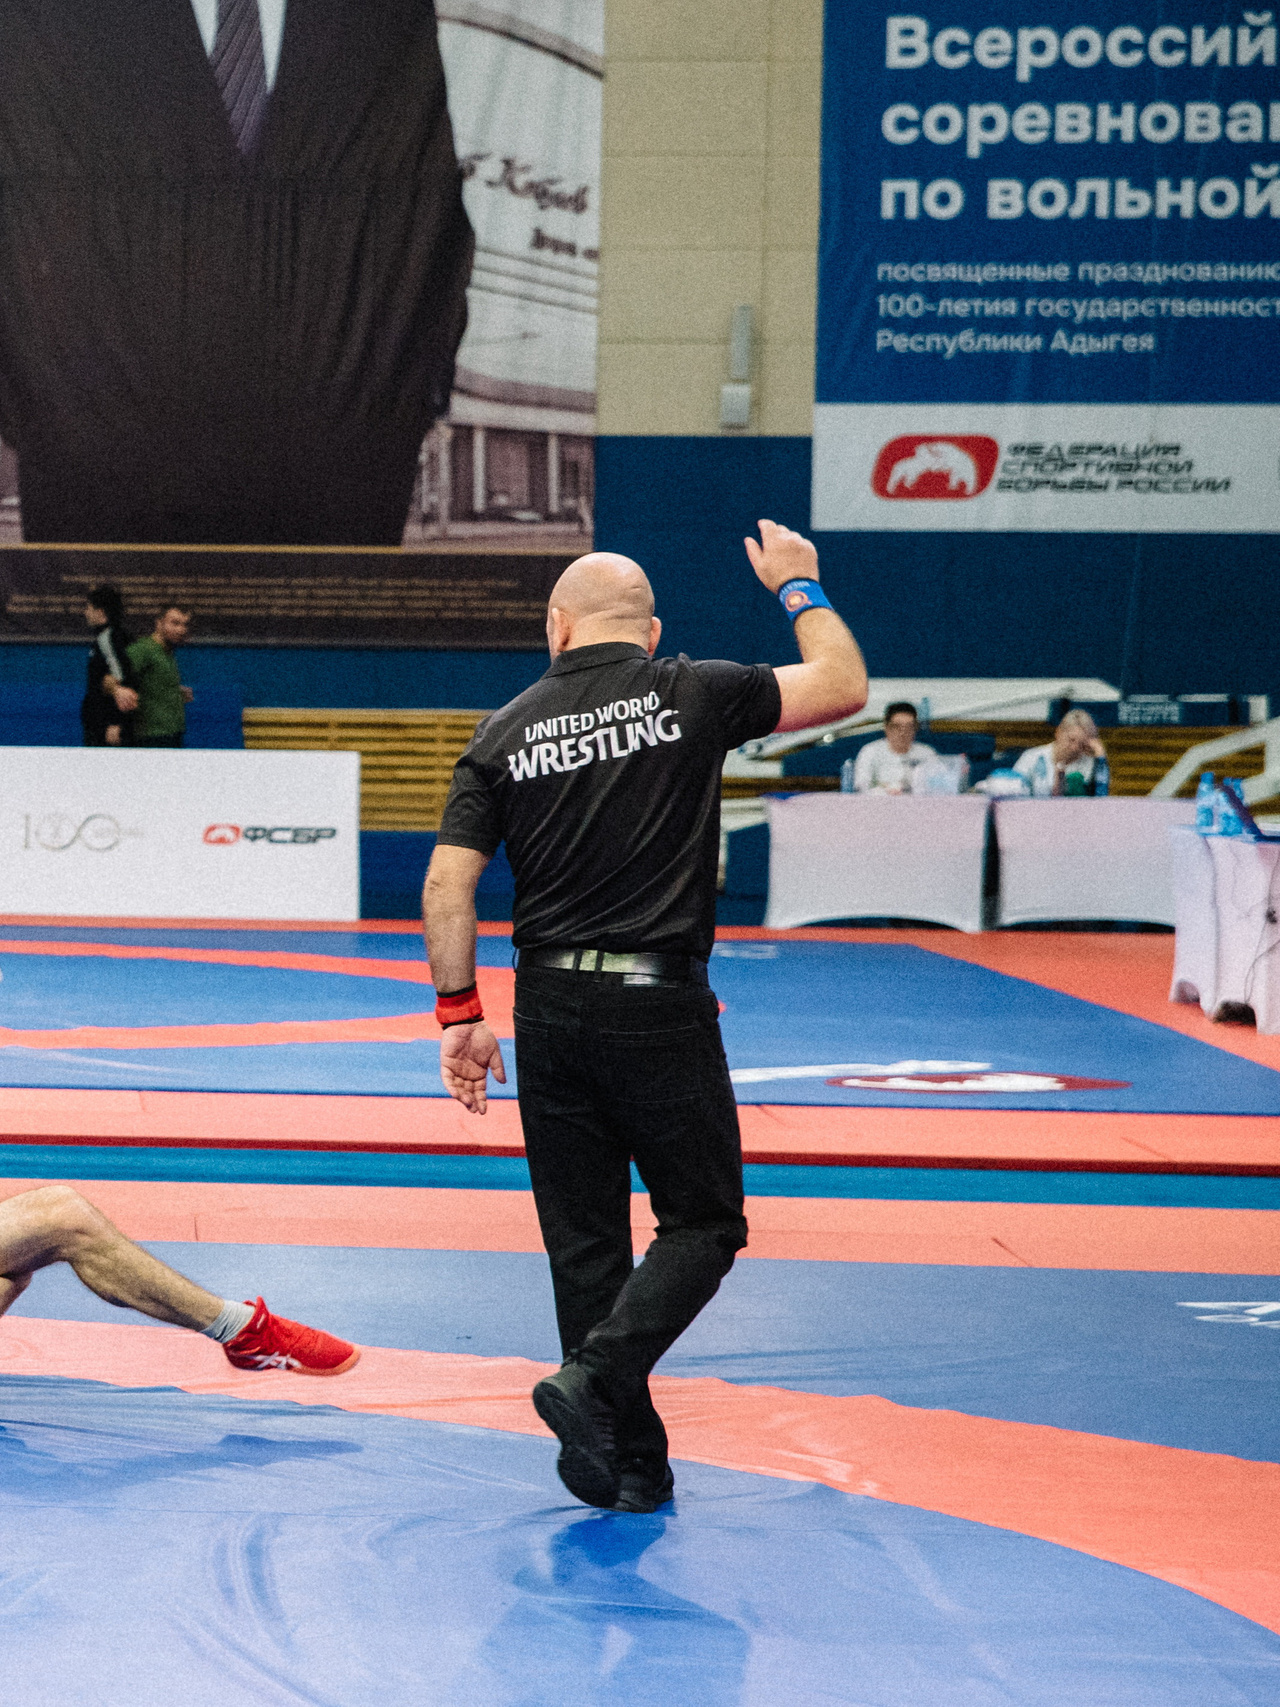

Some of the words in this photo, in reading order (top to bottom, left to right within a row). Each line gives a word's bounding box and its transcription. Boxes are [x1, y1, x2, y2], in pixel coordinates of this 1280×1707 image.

[885, 12, 1276, 82] Всероссий
[881, 102, 1280, 159] соревнова
[881, 179, 964, 220] по
[987, 164, 1280, 219] вольной
[876, 263, 1071, 284] посвященные
[878, 293, 1018, 318] 100-летия
[876, 328, 1043, 359] Республики
[1050, 329, 1155, 355] Адыгея
[507, 709, 682, 783] WRESTLING
[524, 712, 595, 743] UNITED
